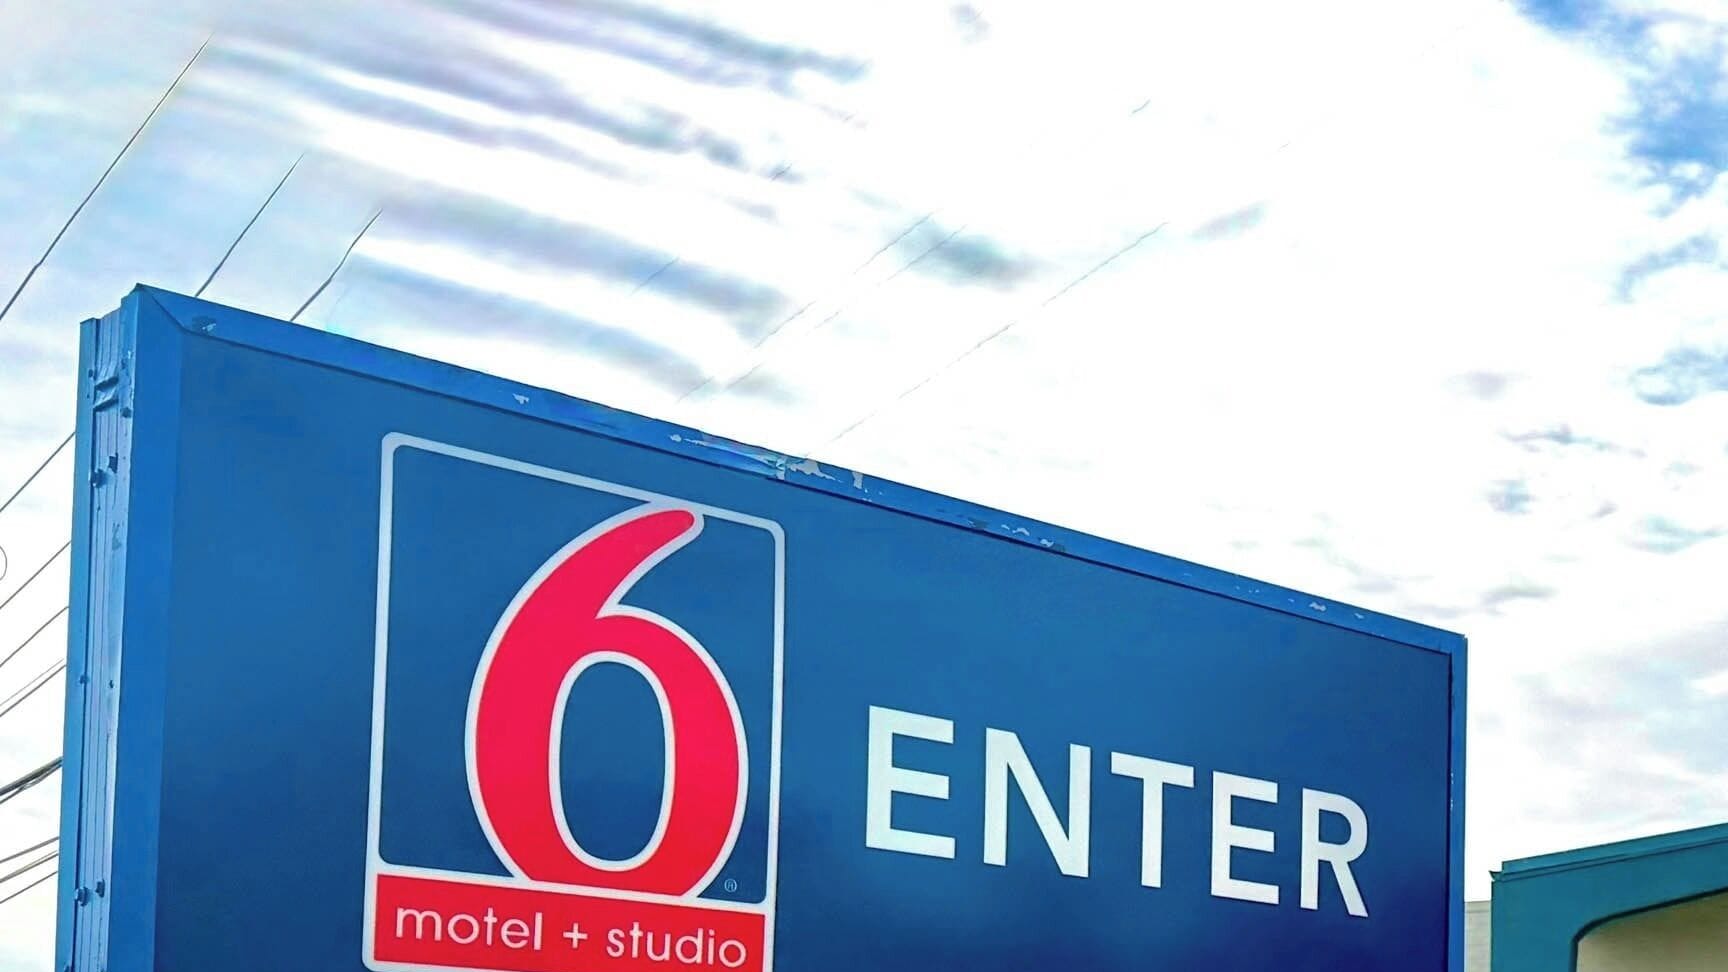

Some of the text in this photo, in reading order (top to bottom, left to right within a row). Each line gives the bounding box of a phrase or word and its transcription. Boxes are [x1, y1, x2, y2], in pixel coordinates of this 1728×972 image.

[464, 501, 750, 898] 6
[866, 705, 1369, 918] ENTER
[395, 906, 542, 951] motel
[607, 926, 747, 968] studio
